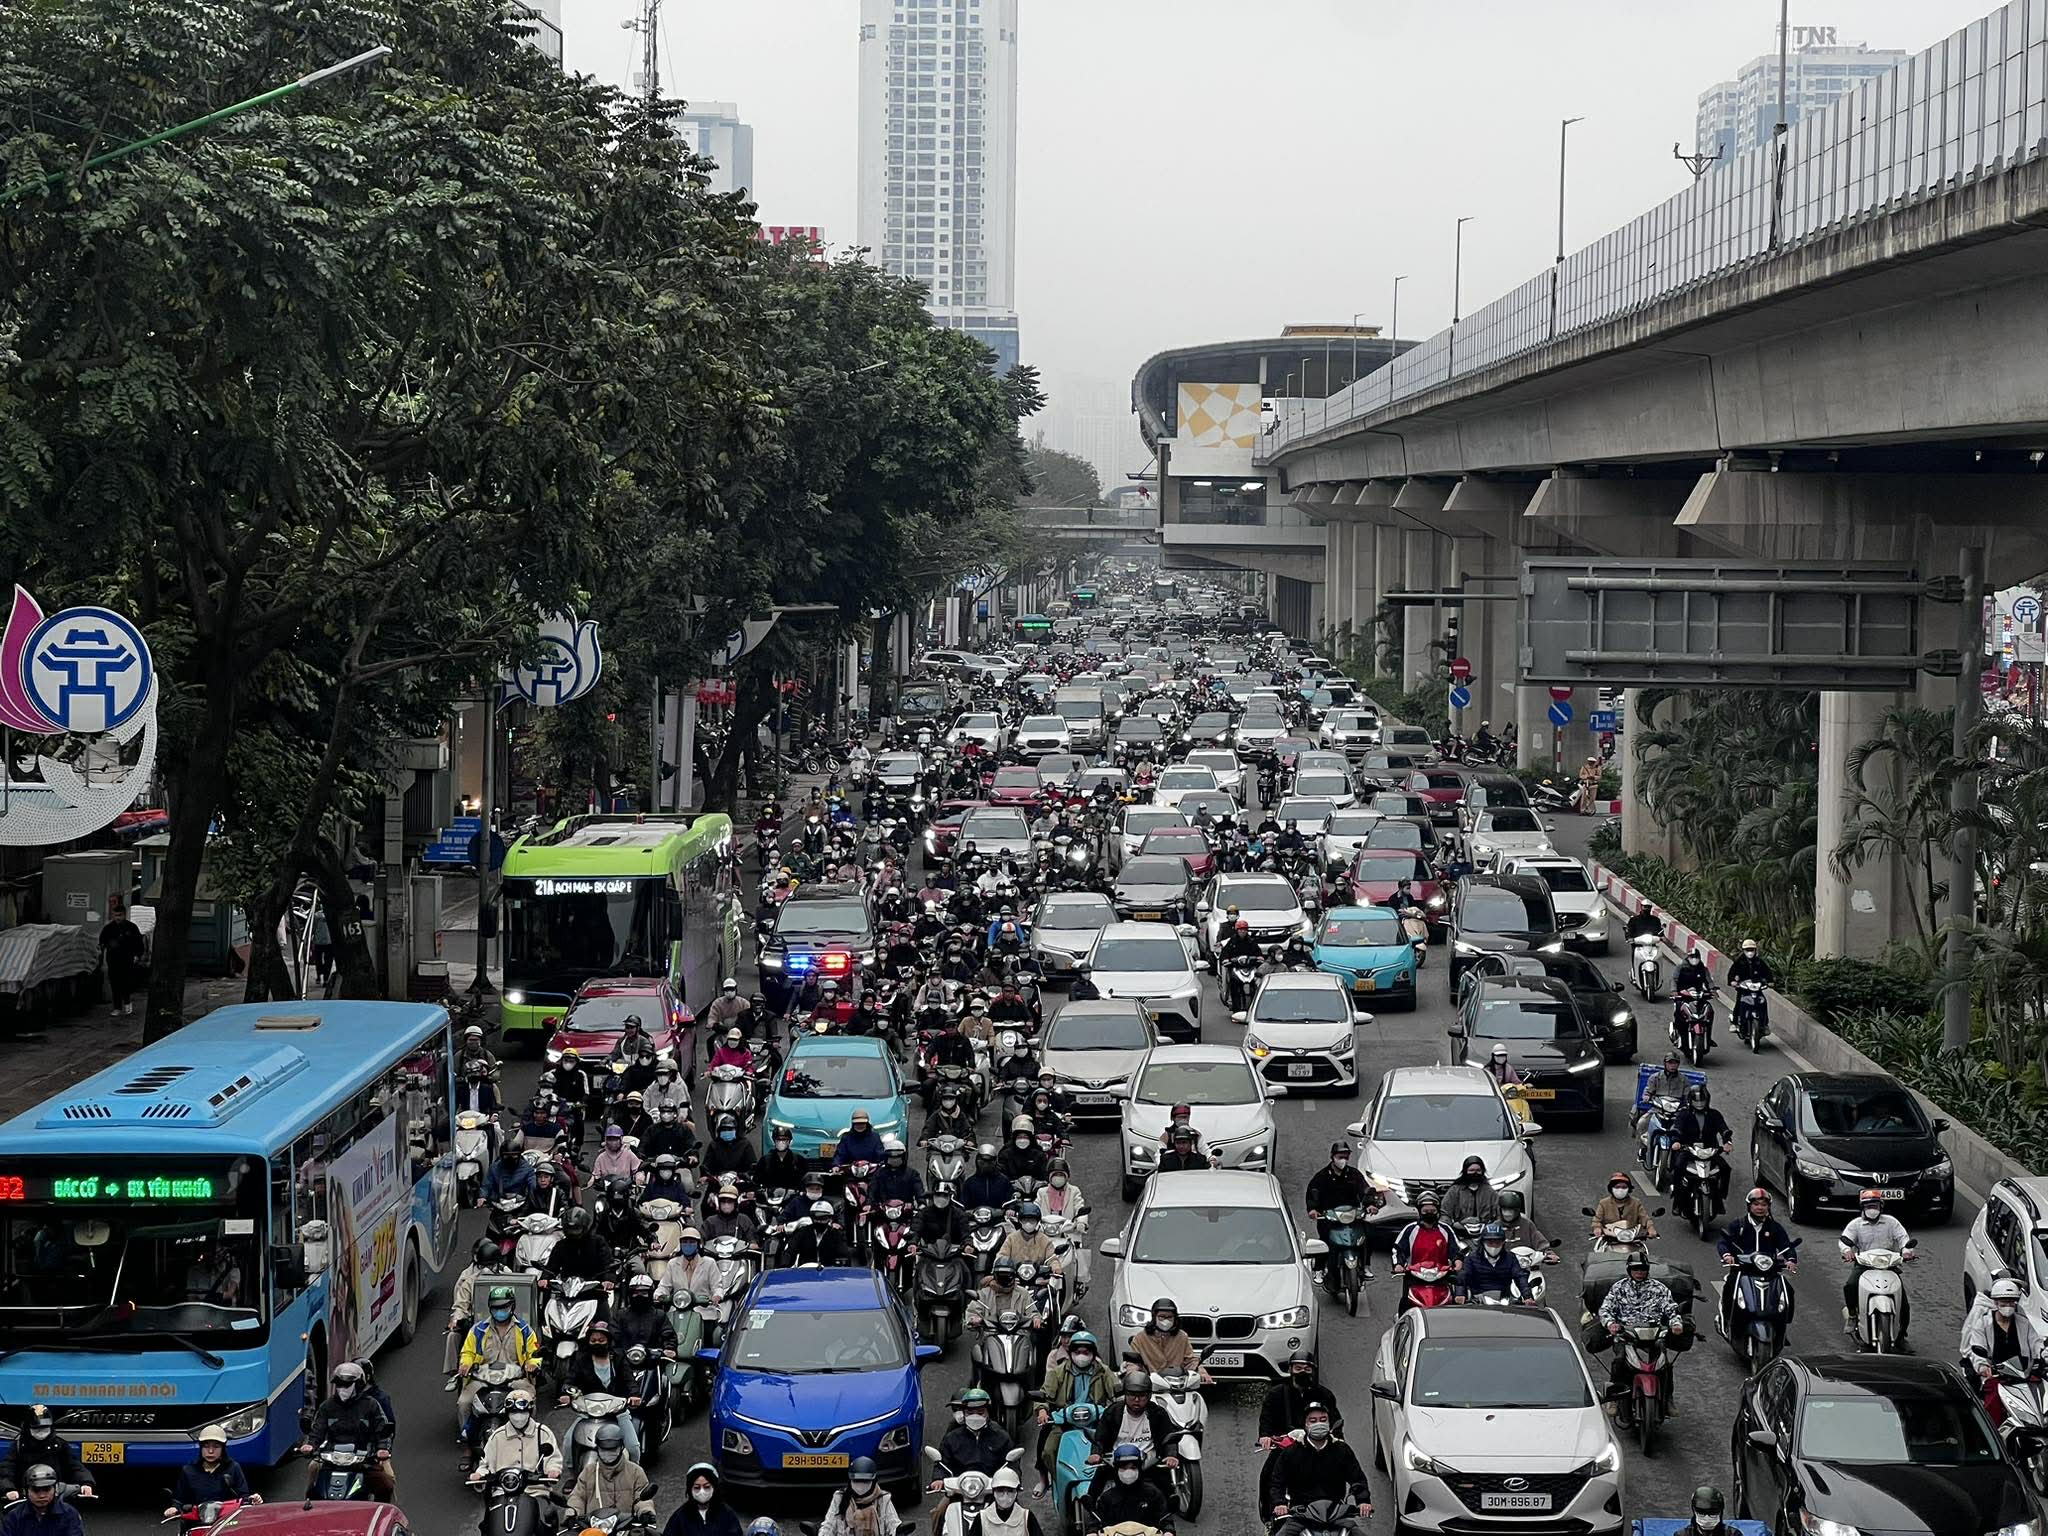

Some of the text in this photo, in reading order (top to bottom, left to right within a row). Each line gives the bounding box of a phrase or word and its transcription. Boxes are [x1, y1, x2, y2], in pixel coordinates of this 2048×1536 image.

[1793, 26, 1836, 45] TNR
[535, 880, 554, 896] 21A
[127, 1180, 146, 1197] BX
[148, 1177, 170, 1197] YÊN
[172, 1178, 212, 1197] NGHĨA
[86, 1453, 120, 1462] 205.19
[1488, 1497, 1546, 1507] 30M-896.87
